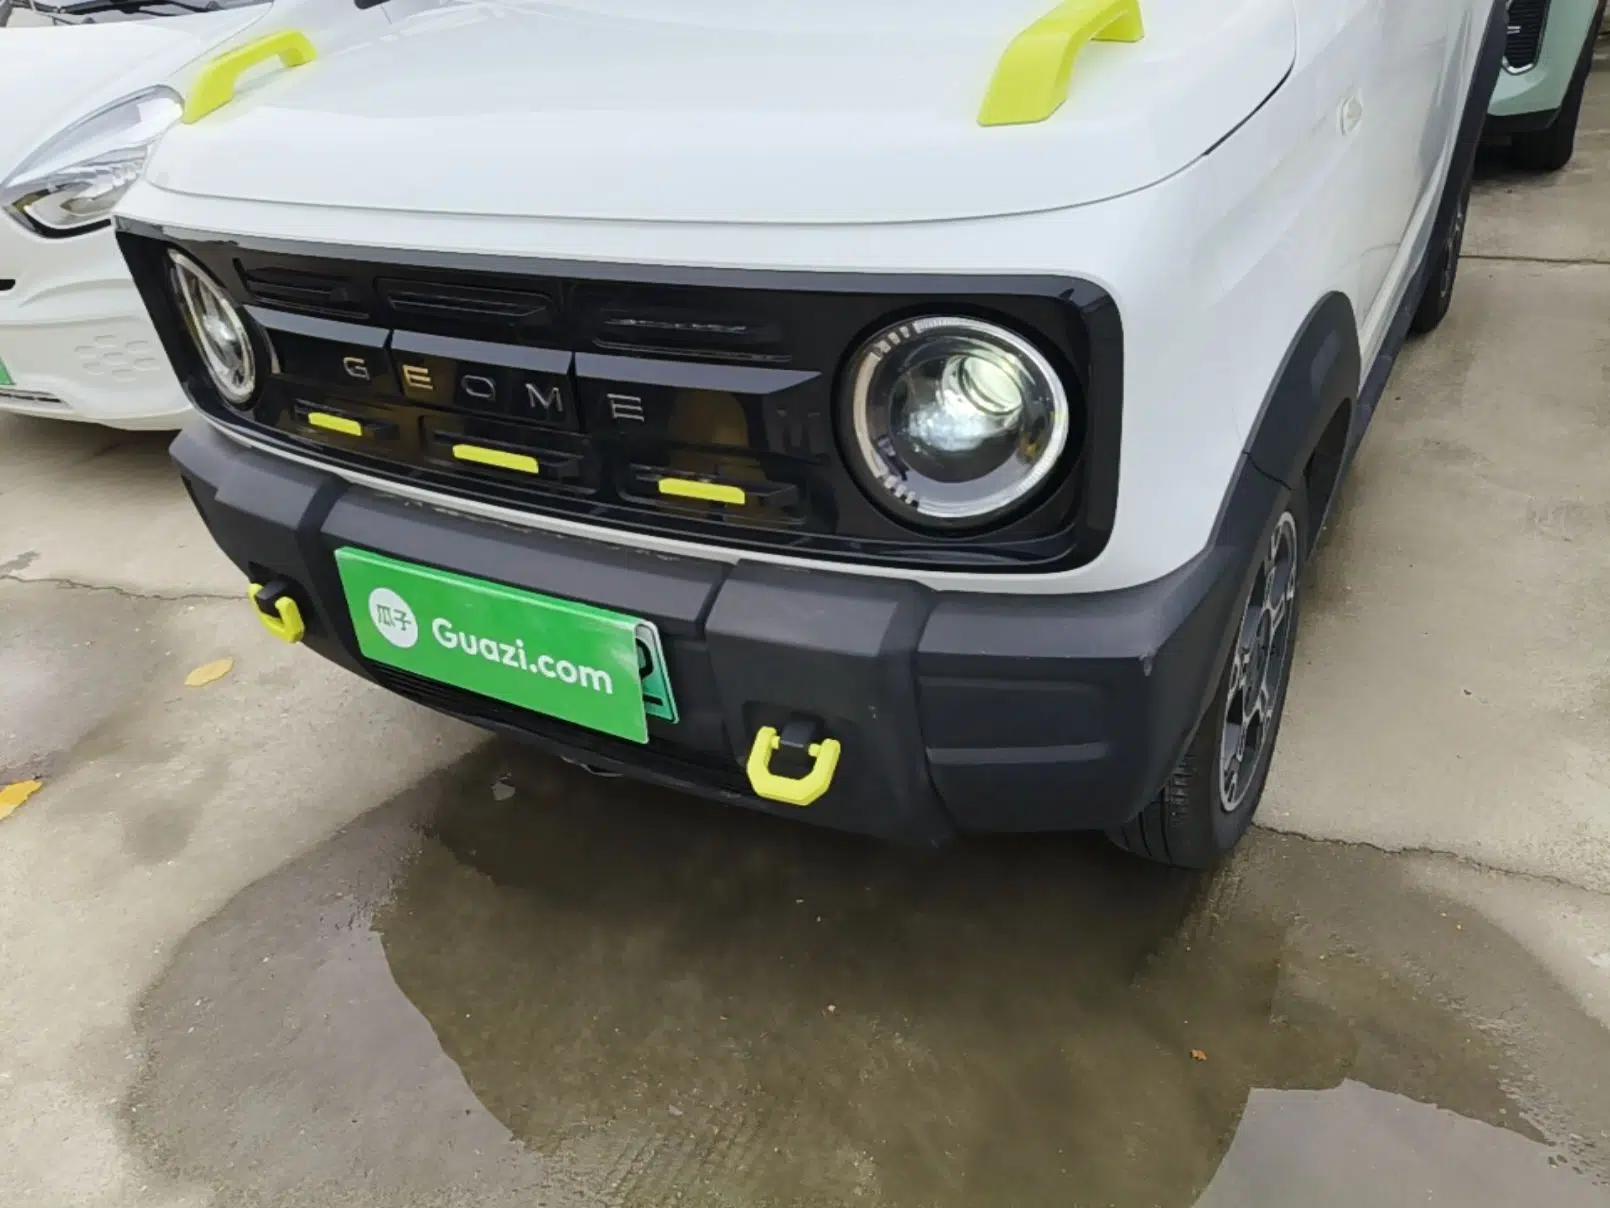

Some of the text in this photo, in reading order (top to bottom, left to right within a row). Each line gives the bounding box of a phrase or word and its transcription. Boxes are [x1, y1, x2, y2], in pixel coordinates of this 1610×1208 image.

[343, 356, 645, 422] GEOME
[376, 603, 412, 632] 瓜子
[432, 617, 613, 694] Guazi.com
